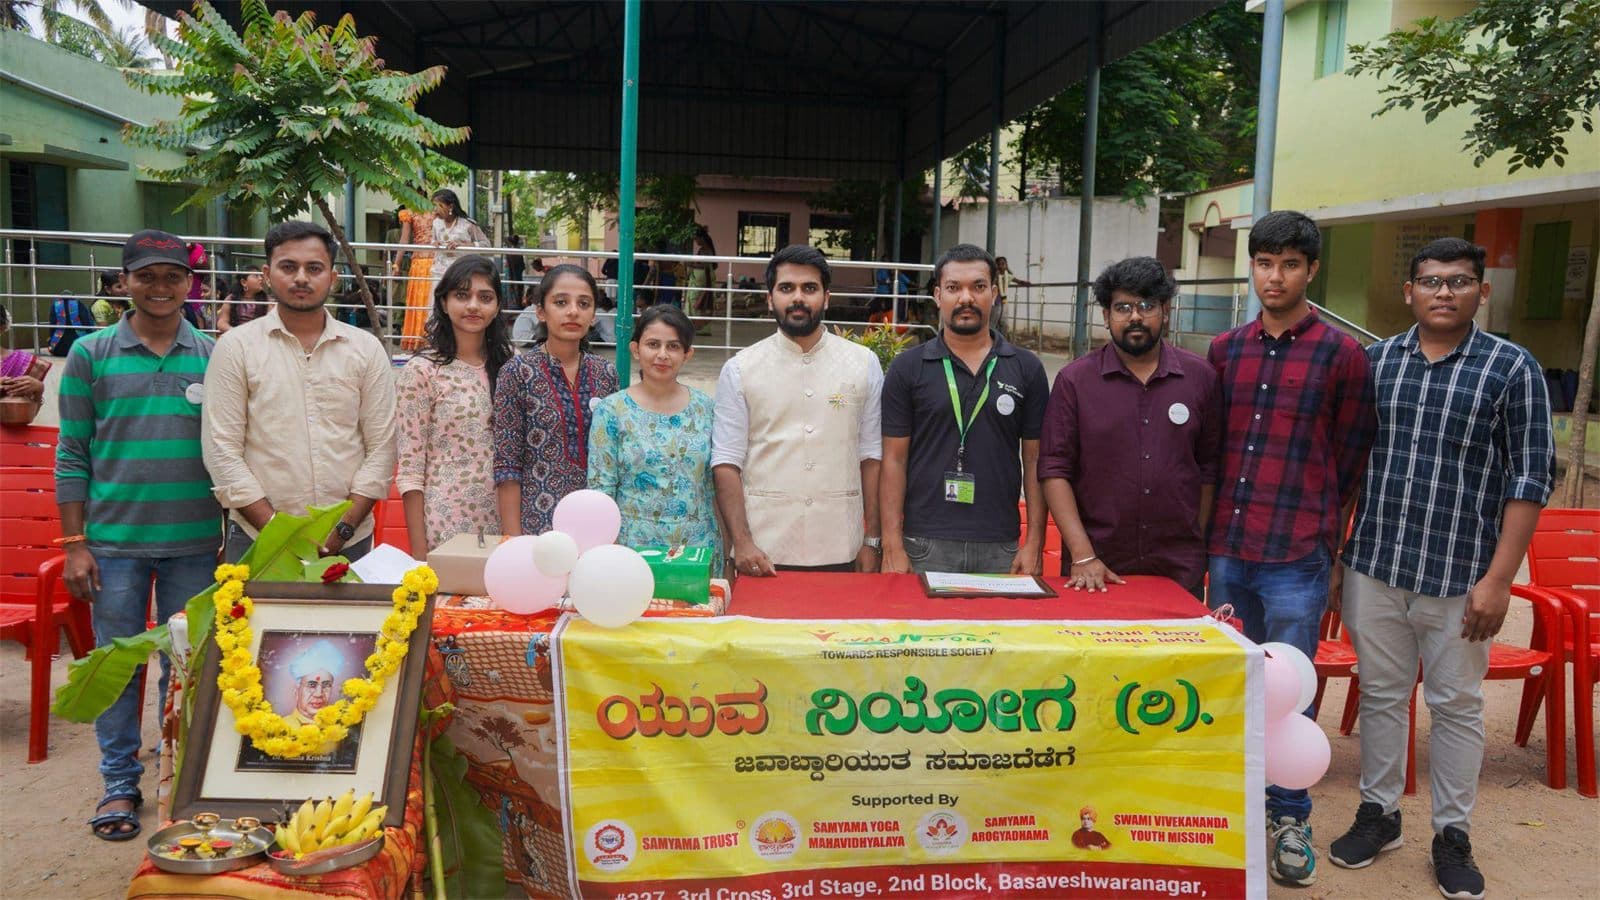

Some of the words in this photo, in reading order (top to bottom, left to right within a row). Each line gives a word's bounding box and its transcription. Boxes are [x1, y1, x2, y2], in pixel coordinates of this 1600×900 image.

[822, 650, 874, 659] TOWARDS
[876, 648, 947, 658] RESPONSIBLE
[951, 647, 995, 657] SOCIETY
[596, 678, 769, 740] ಯುವ
[805, 674, 1076, 736] ನಿಯೋಗ
[735, 748, 911, 781] ಜವಾಬ್ದಾರಿಯುತ
[926, 746, 1076, 771] ಸಮಾಜದೆಡೆಗೆ
[852, 793, 933, 808] Supported
[938, 793, 959, 807] By
[813, 821, 868, 833] SAMYAMA
[870, 820, 900, 832] YOGA
[984, 815, 1036, 828] SAMYAMA
[1113, 814, 1152, 827] SWAMI
[1154, 815, 1229, 830] VIVEKANANDA
[642, 836, 701, 851] SAMYAMA
[702, 832, 739, 849] TRUST
[808, 835, 905, 849] MAHAVIDHYALAYA
[971, 829, 1049, 842] AROGYADHAMA
[1130, 830, 1165, 843] YOUTH
[1167, 831, 1214, 845] MISSION
[781, 879, 814, 899] 3rd
[820, 879, 883, 897] Stage,
[888, 874, 925, 892] 2nd
[931, 873, 992, 893] Block,
[999, 872, 1207, 898] Basaveshwaranagar,
